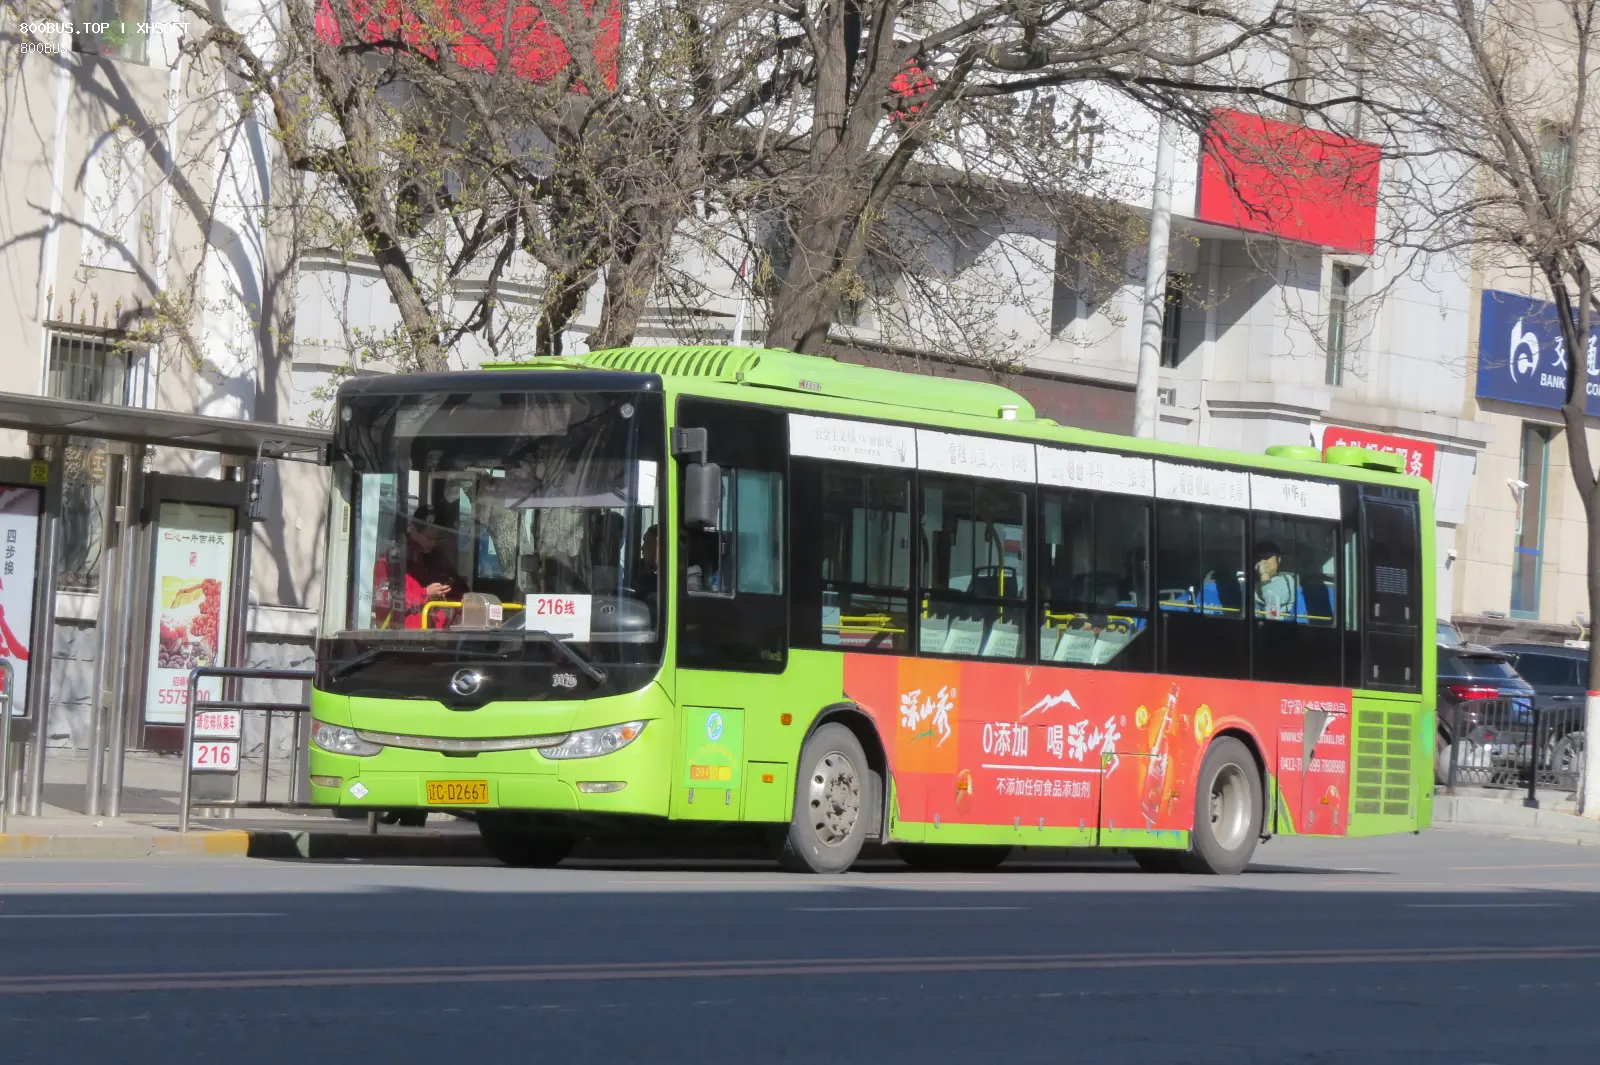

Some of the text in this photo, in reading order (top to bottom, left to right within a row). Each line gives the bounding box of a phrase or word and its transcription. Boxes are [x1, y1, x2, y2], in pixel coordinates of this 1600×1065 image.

[1540, 373, 1566, 390] BANK
[537, 598, 576, 616] 216线
[197, 745, 231, 765] 216
[996, 777, 1091, 799] 不添加任何食品添加剂
